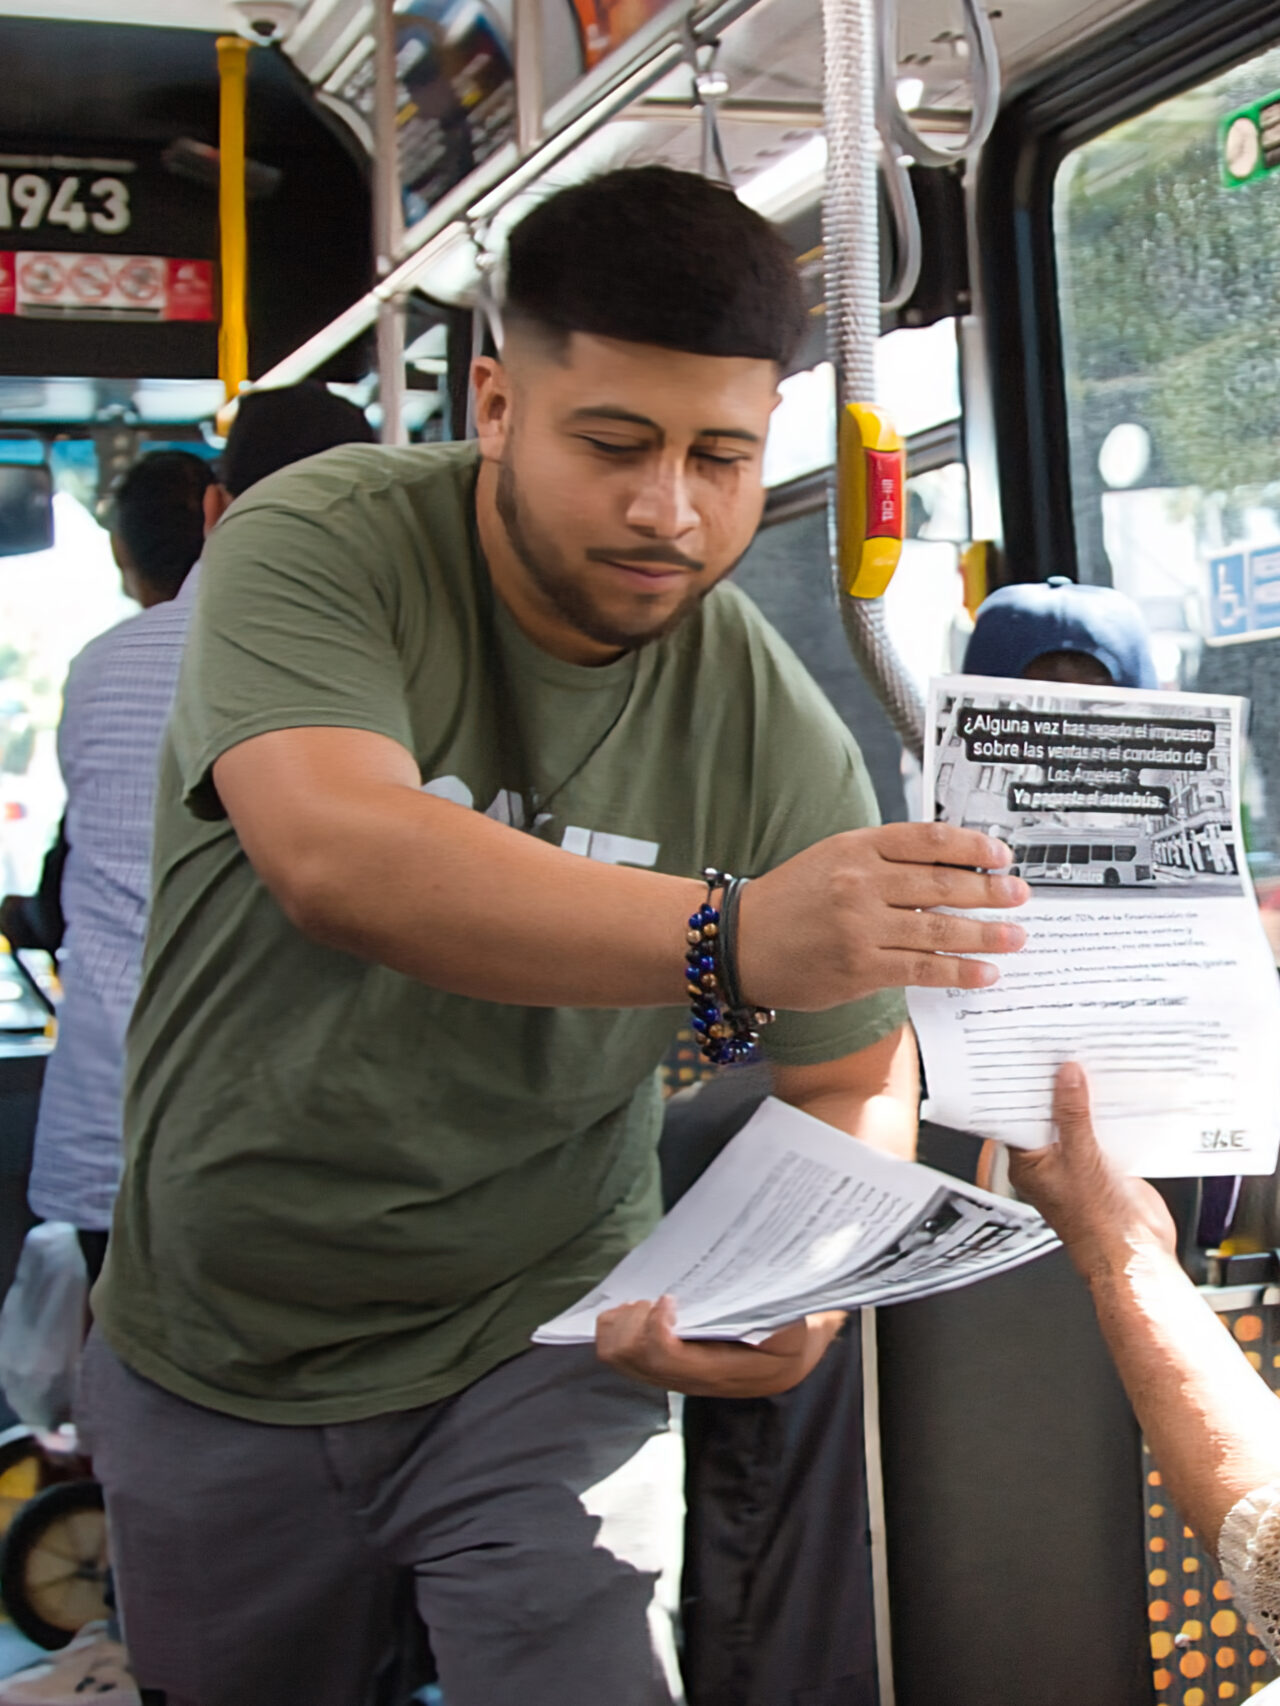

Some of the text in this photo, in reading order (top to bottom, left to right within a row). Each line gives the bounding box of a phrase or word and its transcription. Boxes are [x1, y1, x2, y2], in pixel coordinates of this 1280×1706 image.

[0, 173, 131, 234] 1943
[964, 714, 1029, 736] ¿Alguna
[1034, 721, 1060, 735] vez
[1062, 719, 1085, 737] has
[1134, 723, 1148, 738] el
[1149, 723, 1212, 743] impuesto
[973, 740, 1020, 758] sobre
[1023, 741, 1045, 758] las
[1047, 745, 1090, 760] ventas
[1108, 745, 1121, 760] el
[1122, 746, 1181, 764] condado
[1184, 748, 1204, 765] de
[1048, 765, 1072, 782] Los
[1013, 788, 1031, 805] Ya
[1086, 790, 1099, 806] el
